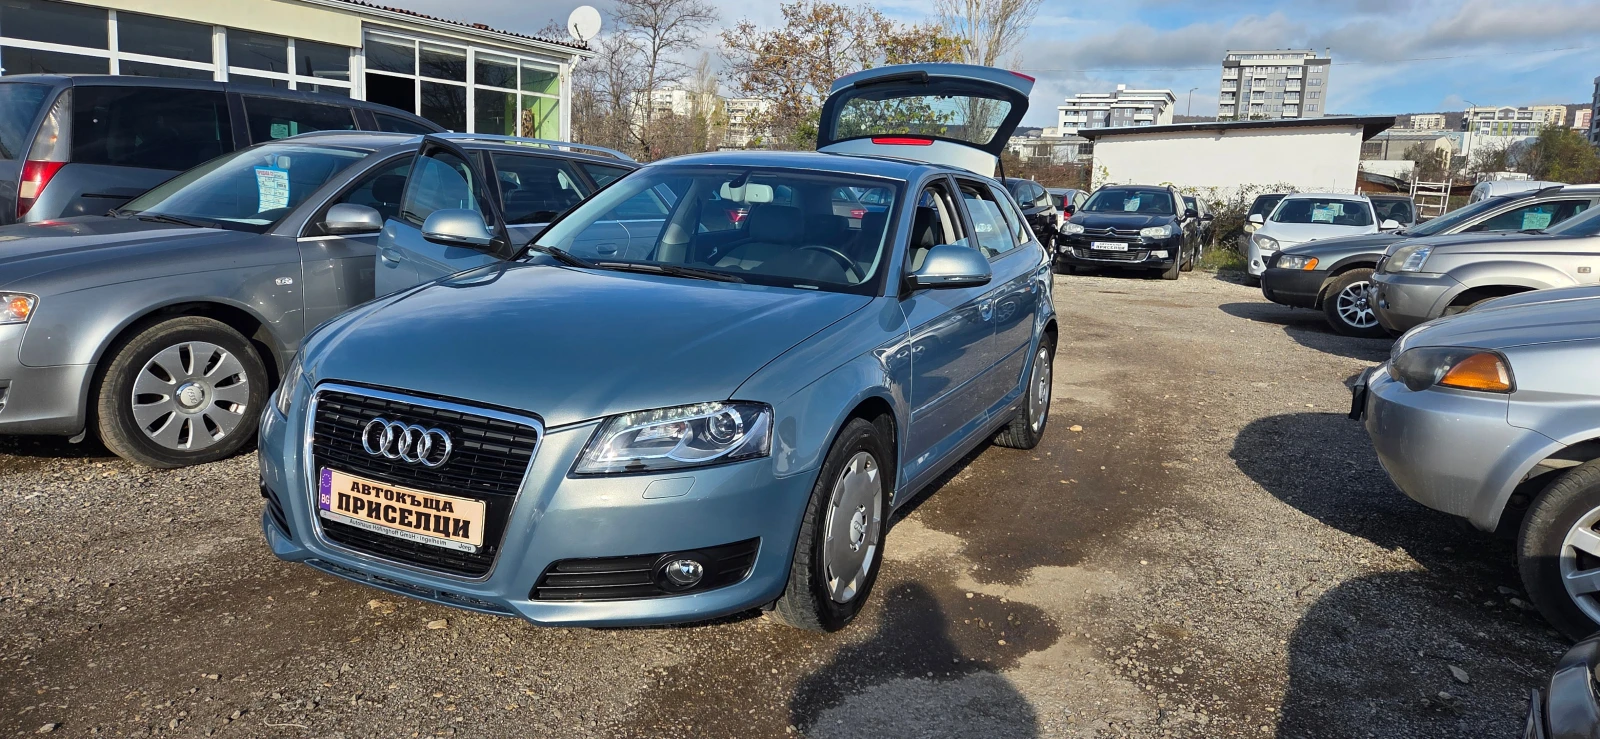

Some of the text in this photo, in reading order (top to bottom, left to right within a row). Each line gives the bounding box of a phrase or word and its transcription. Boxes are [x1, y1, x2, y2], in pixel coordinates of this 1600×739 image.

[321, 494, 330, 505] BG
[350, 481, 454, 513] АВТОКЪЩА
[337, 492, 471, 539] ПРИСЕЛЦИ
[349, 518, 372, 529] Autohaus
[399, 530, 416, 540] GmbH
[419, 535, 447, 546] Ingelheim
[458, 543, 472, 552] Jeep
